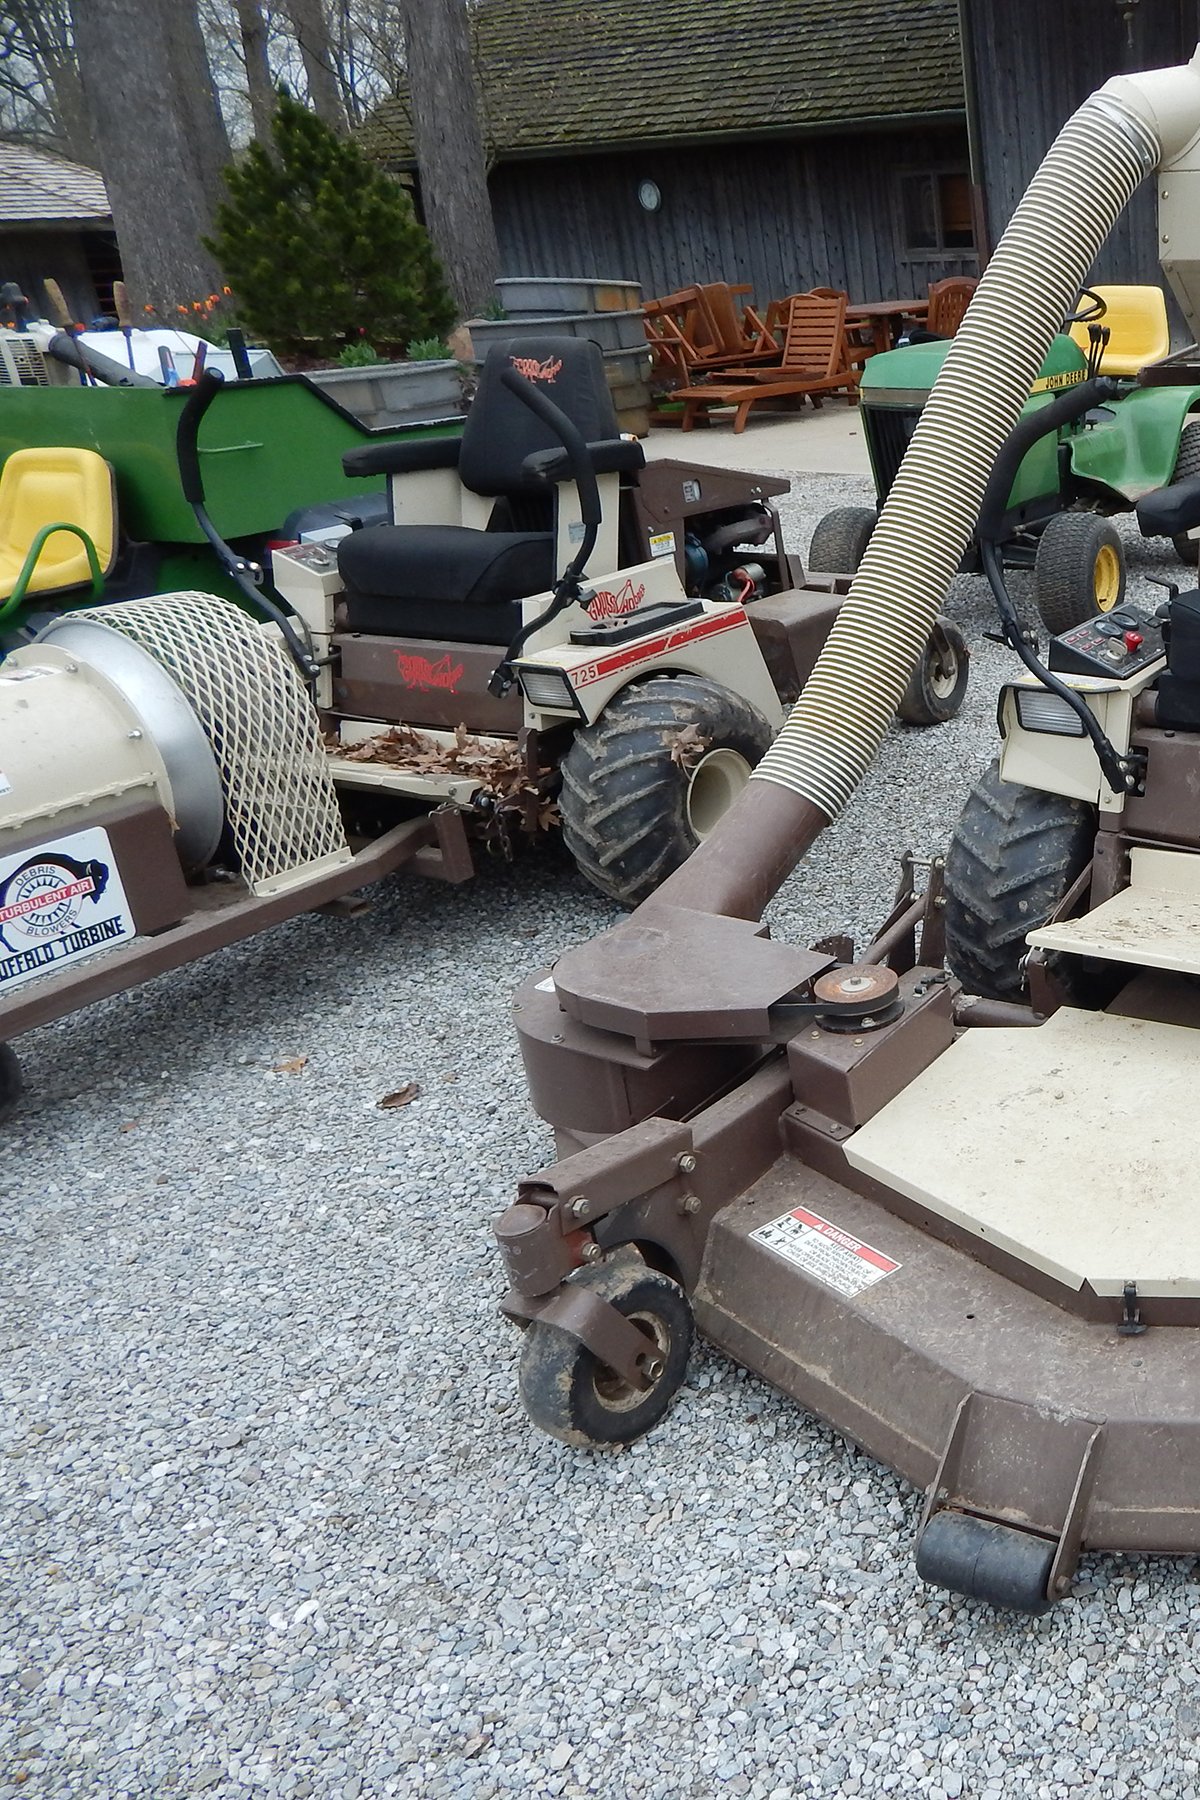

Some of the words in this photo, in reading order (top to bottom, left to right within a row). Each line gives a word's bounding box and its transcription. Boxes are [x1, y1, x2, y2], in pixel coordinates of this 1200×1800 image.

[1045, 375, 1063, 389] JOHN
[1065, 370, 1086, 385] DEERE
[571, 664, 597, 686] 725
[15, 865, 57, 887] DEBRIS
[0, 891, 69, 921] TURBULENT
[70, 880, 91, 896] AIR
[26, 908, 78, 937] BLOWERS
[60, 915, 126, 953] TURBINE
[823, 1227, 863, 1251] DANGER
